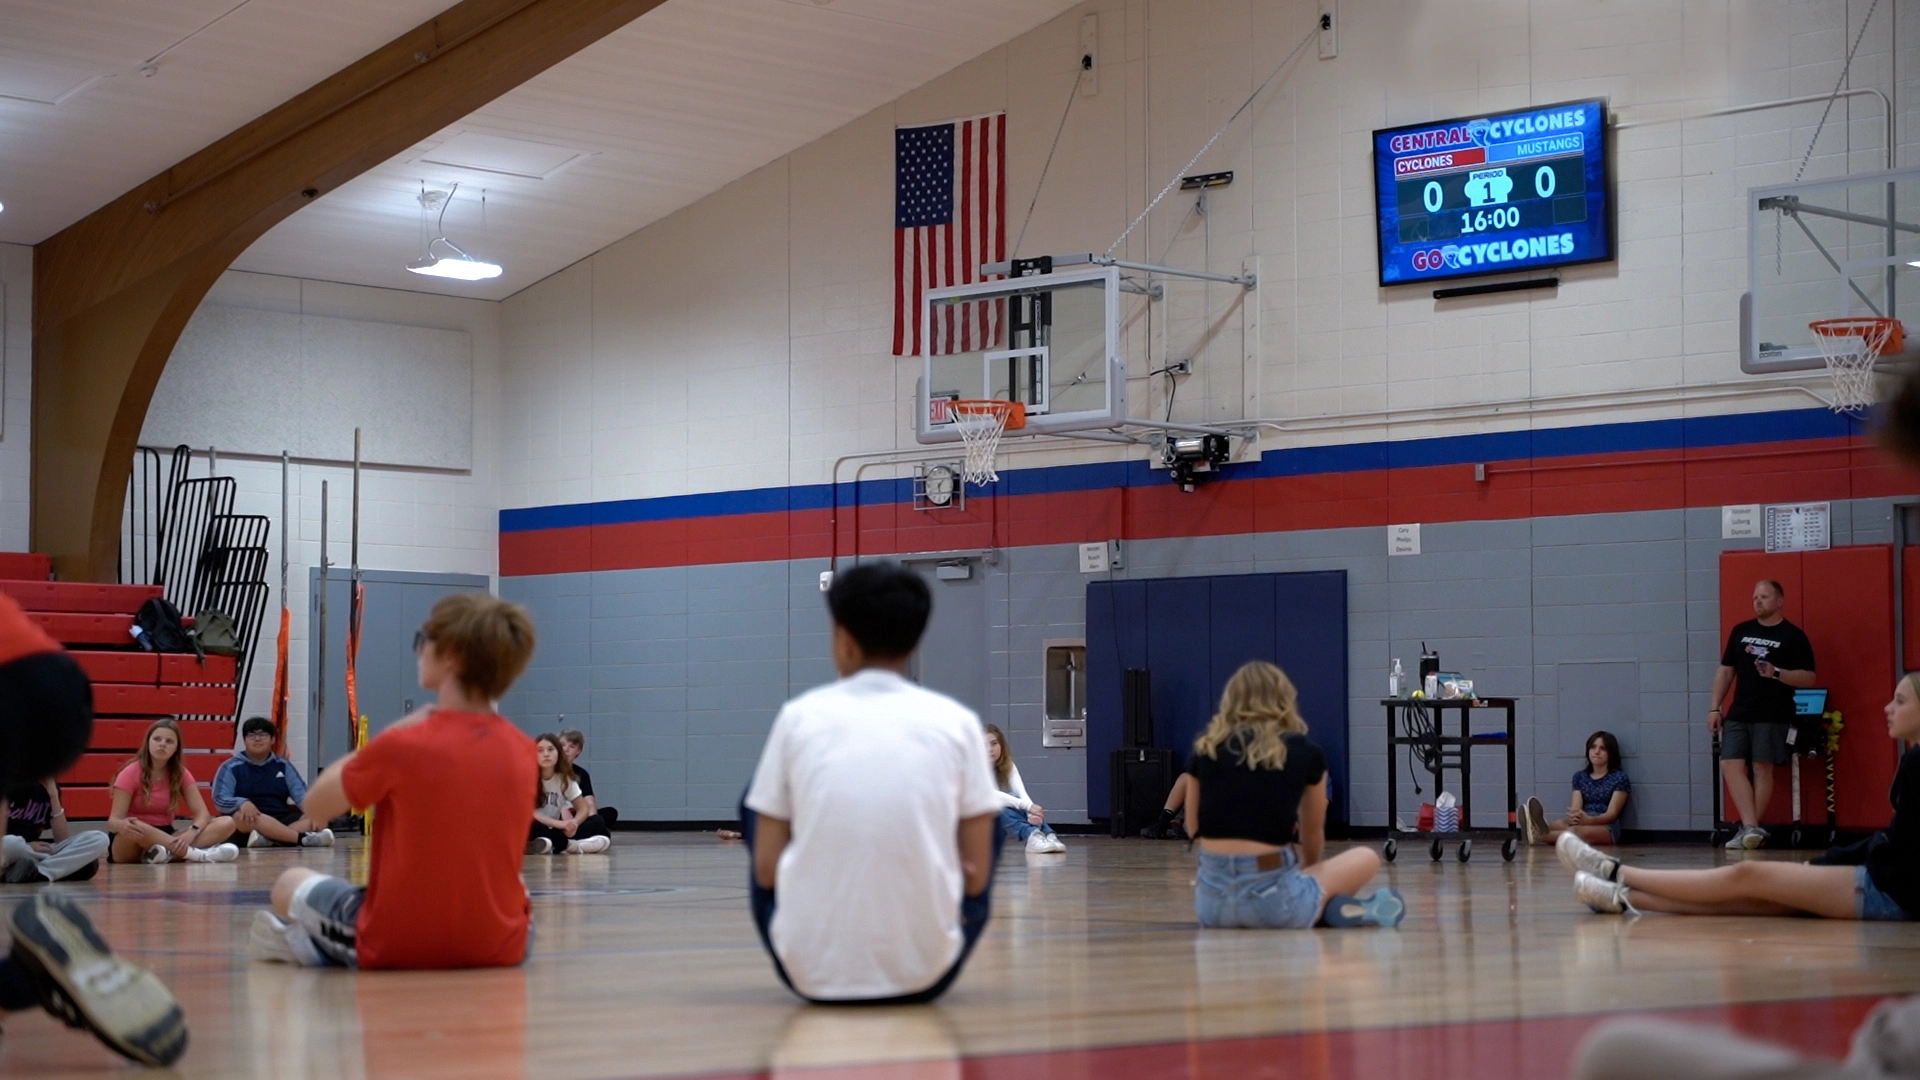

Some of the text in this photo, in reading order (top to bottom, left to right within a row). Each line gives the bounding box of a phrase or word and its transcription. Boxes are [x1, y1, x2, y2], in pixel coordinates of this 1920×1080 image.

[1390, 110, 1586, 154] CENTRAL CYCLONES
[1517, 137, 1580, 155] MUSTANGS
[1398, 154, 1453, 172] CYCLONES
[1472, 170, 1504, 180] PERIOD
[1482, 182, 1495, 203] 1
[1535, 165, 1556, 198] 0
[1423, 181, 1443, 213] 0
[1461, 207, 1520, 233] 16:00
[1412, 233, 1574, 272] GO CYCLONES
